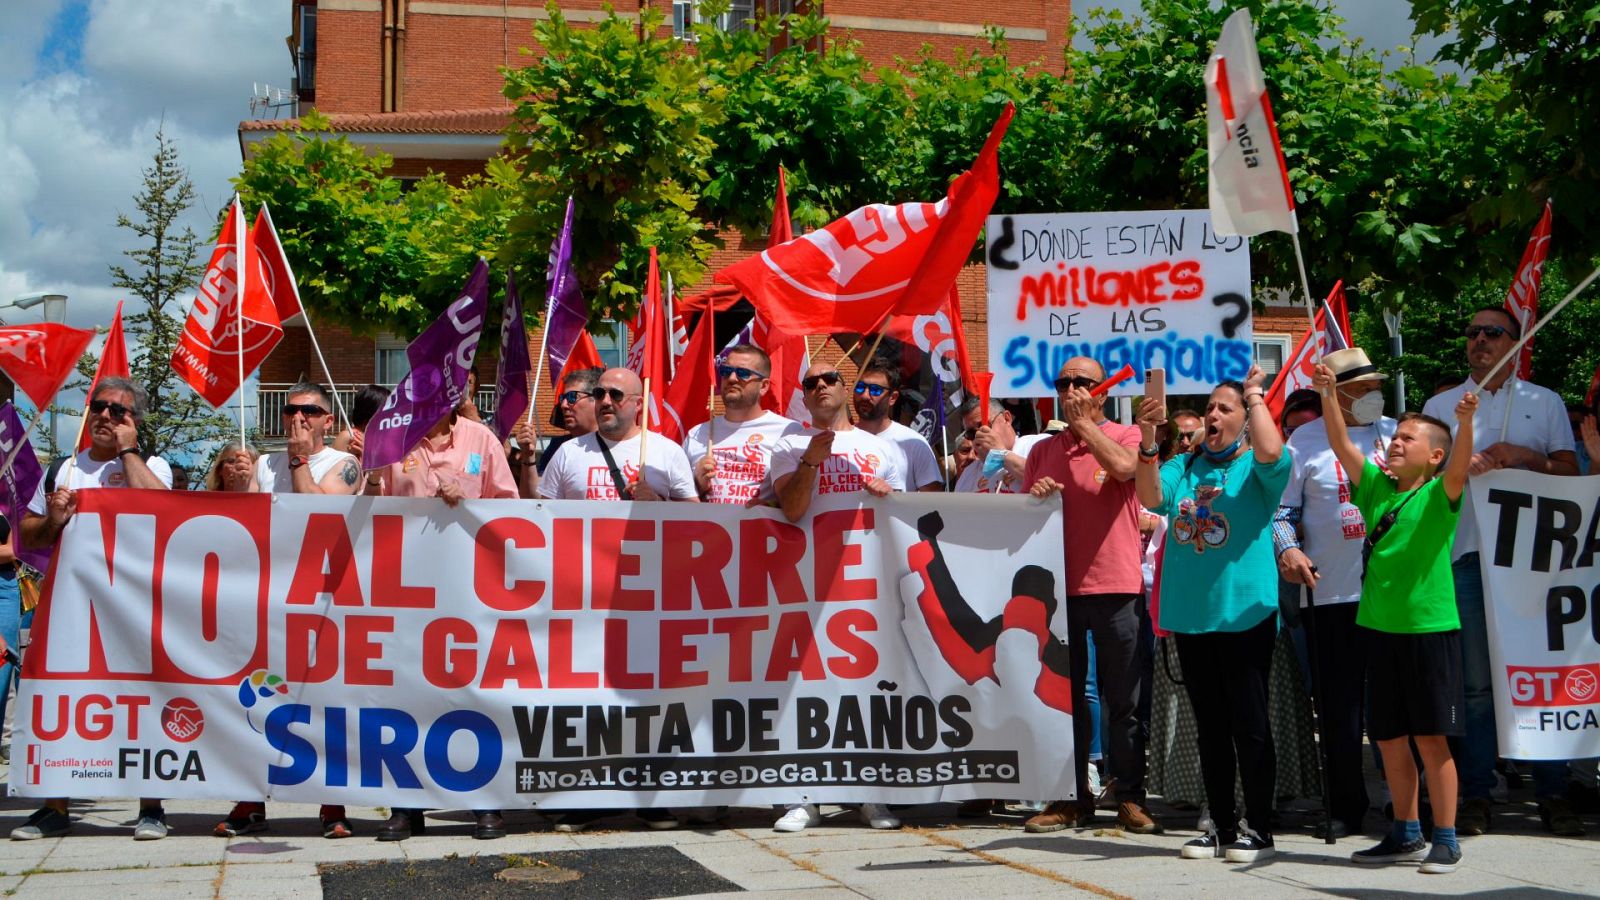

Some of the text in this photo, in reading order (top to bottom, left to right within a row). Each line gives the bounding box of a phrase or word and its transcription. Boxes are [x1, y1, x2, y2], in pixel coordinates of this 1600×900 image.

[1236, 123, 1258, 168] ncia
[1106, 217, 1185, 256] ESTÁN
[1050, 312, 1081, 337] DE
[1111, 307, 1167, 334] LAS
[175, 344, 218, 387] www.u
[724, 462, 766, 475] CIERRE
[838, 473, 875, 485] CIERR
[728, 485, 760, 498] SIRO
[833, 484, 863, 493] GALLE
[1342, 523, 1365, 534] VENT
[285, 508, 878, 612] AL CIERRE
[46, 512, 261, 679] NO
[1546, 583, 1600, 651] P
[286, 608, 879, 690] DE GALLETAS
[31, 694, 150, 741] UGT
[512, 680, 974, 758] VENTA DE BAÑOS
[1539, 709, 1600, 732] FICA
[44, 758, 113, 769] Castilla y León
[118, 747, 206, 782] FICA
[265, 704, 503, 793] SIRO
[71, 769, 113, 779] Palencia
[519, 758, 1017, 792] #NoAlCierreDeGalletasSiro
